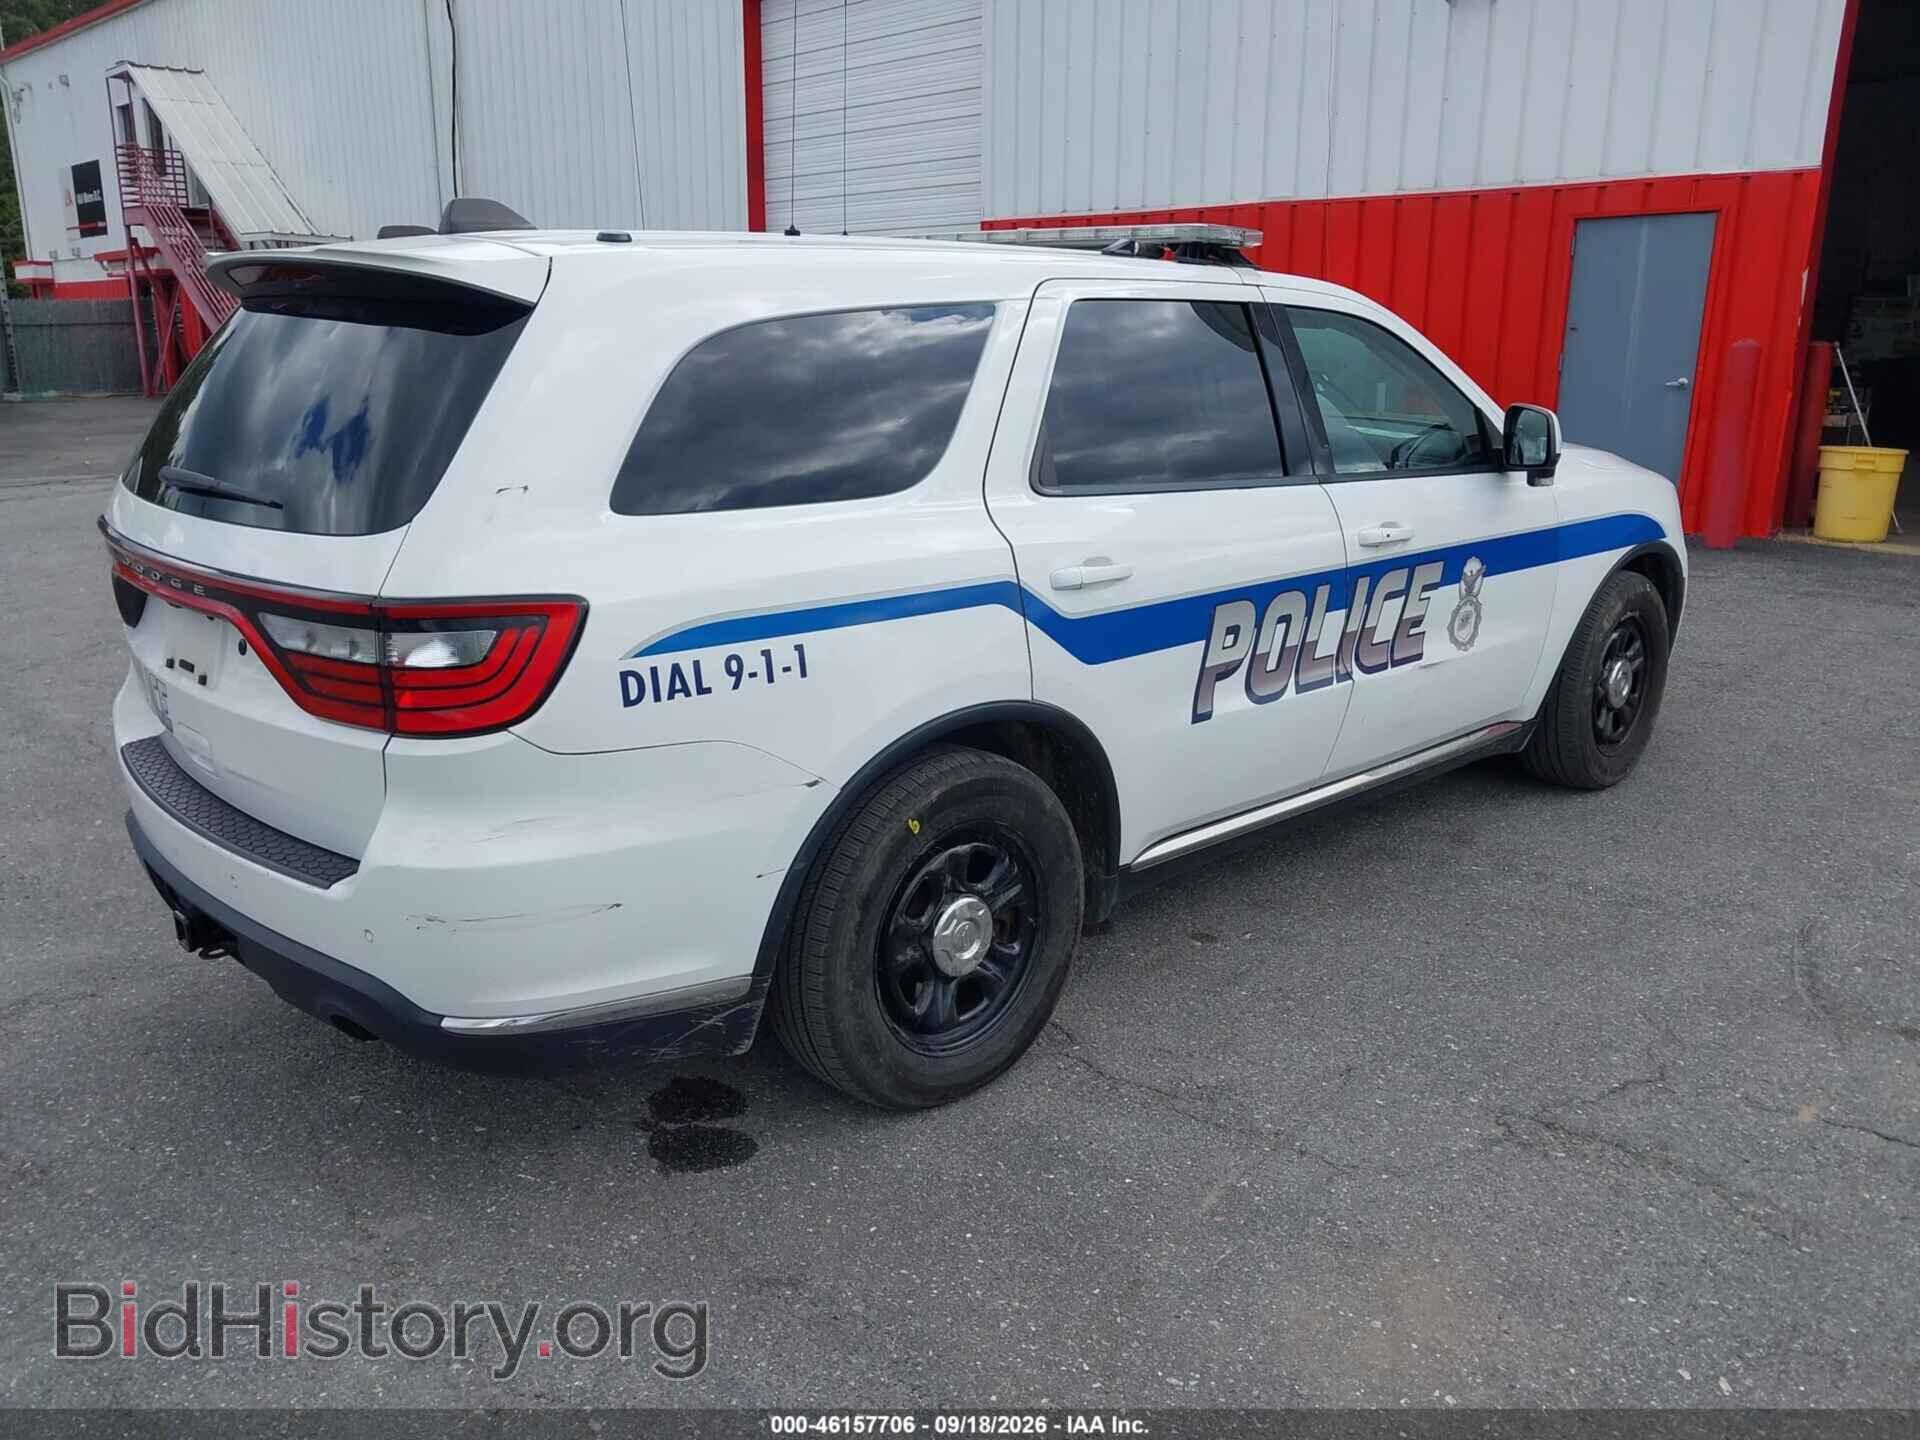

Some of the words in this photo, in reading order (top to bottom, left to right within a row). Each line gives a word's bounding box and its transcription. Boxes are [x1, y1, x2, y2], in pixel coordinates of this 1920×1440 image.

[122, 558, 206, 596] DODGE
[619, 659, 713, 708] DIAL
[723, 643, 808, 691] 9-1-1
[1191, 561, 1445, 725] POLICE
